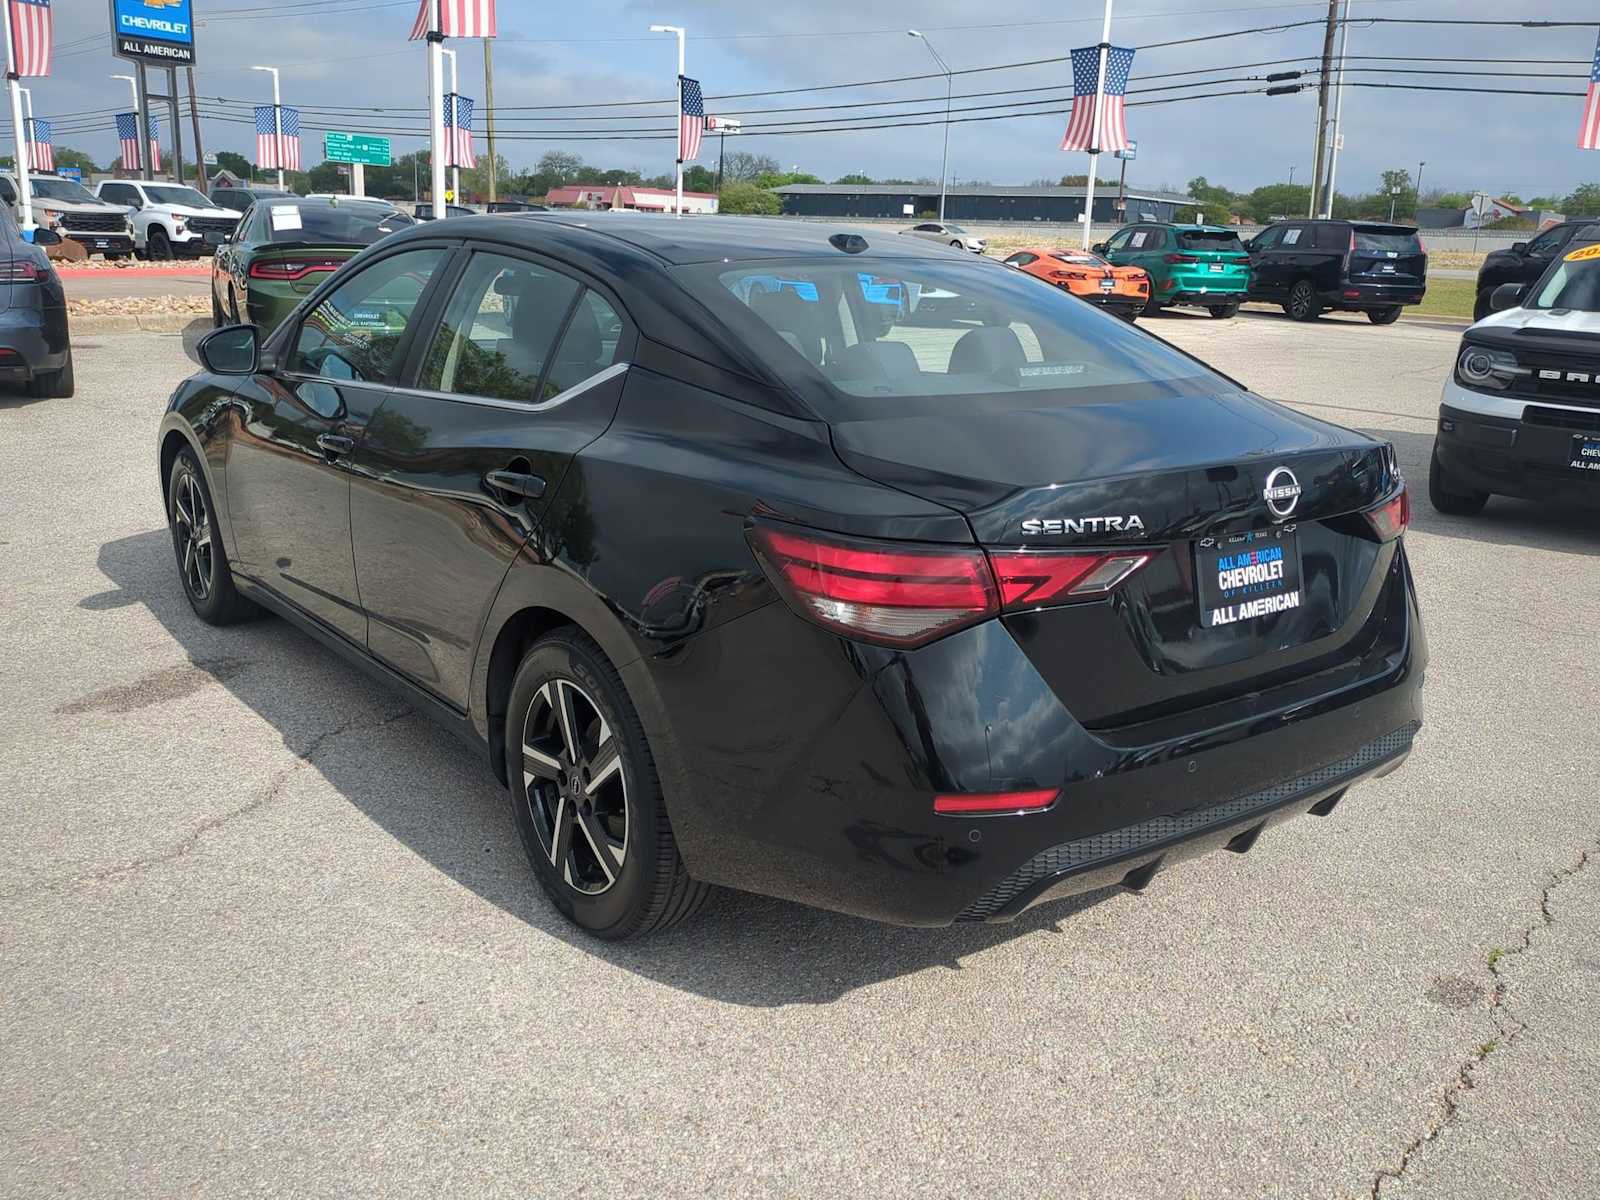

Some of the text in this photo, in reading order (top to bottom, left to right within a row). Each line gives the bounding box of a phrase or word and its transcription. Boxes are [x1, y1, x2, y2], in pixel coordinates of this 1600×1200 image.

[121, 14, 187, 34] CHEVROLET
[123, 41, 191, 59] ALL AMERICAN
[1570, 460, 1586, 469] ALL
[1264, 485, 1301, 500] NISSAN
[1021, 515, 1145, 535] SENTRA
[1218, 546, 1282, 571] ALL AMERICAN
[1218, 560, 1284, 590] CHEVROLET
[1212, 591, 1299, 626] ALL AMERICAN
